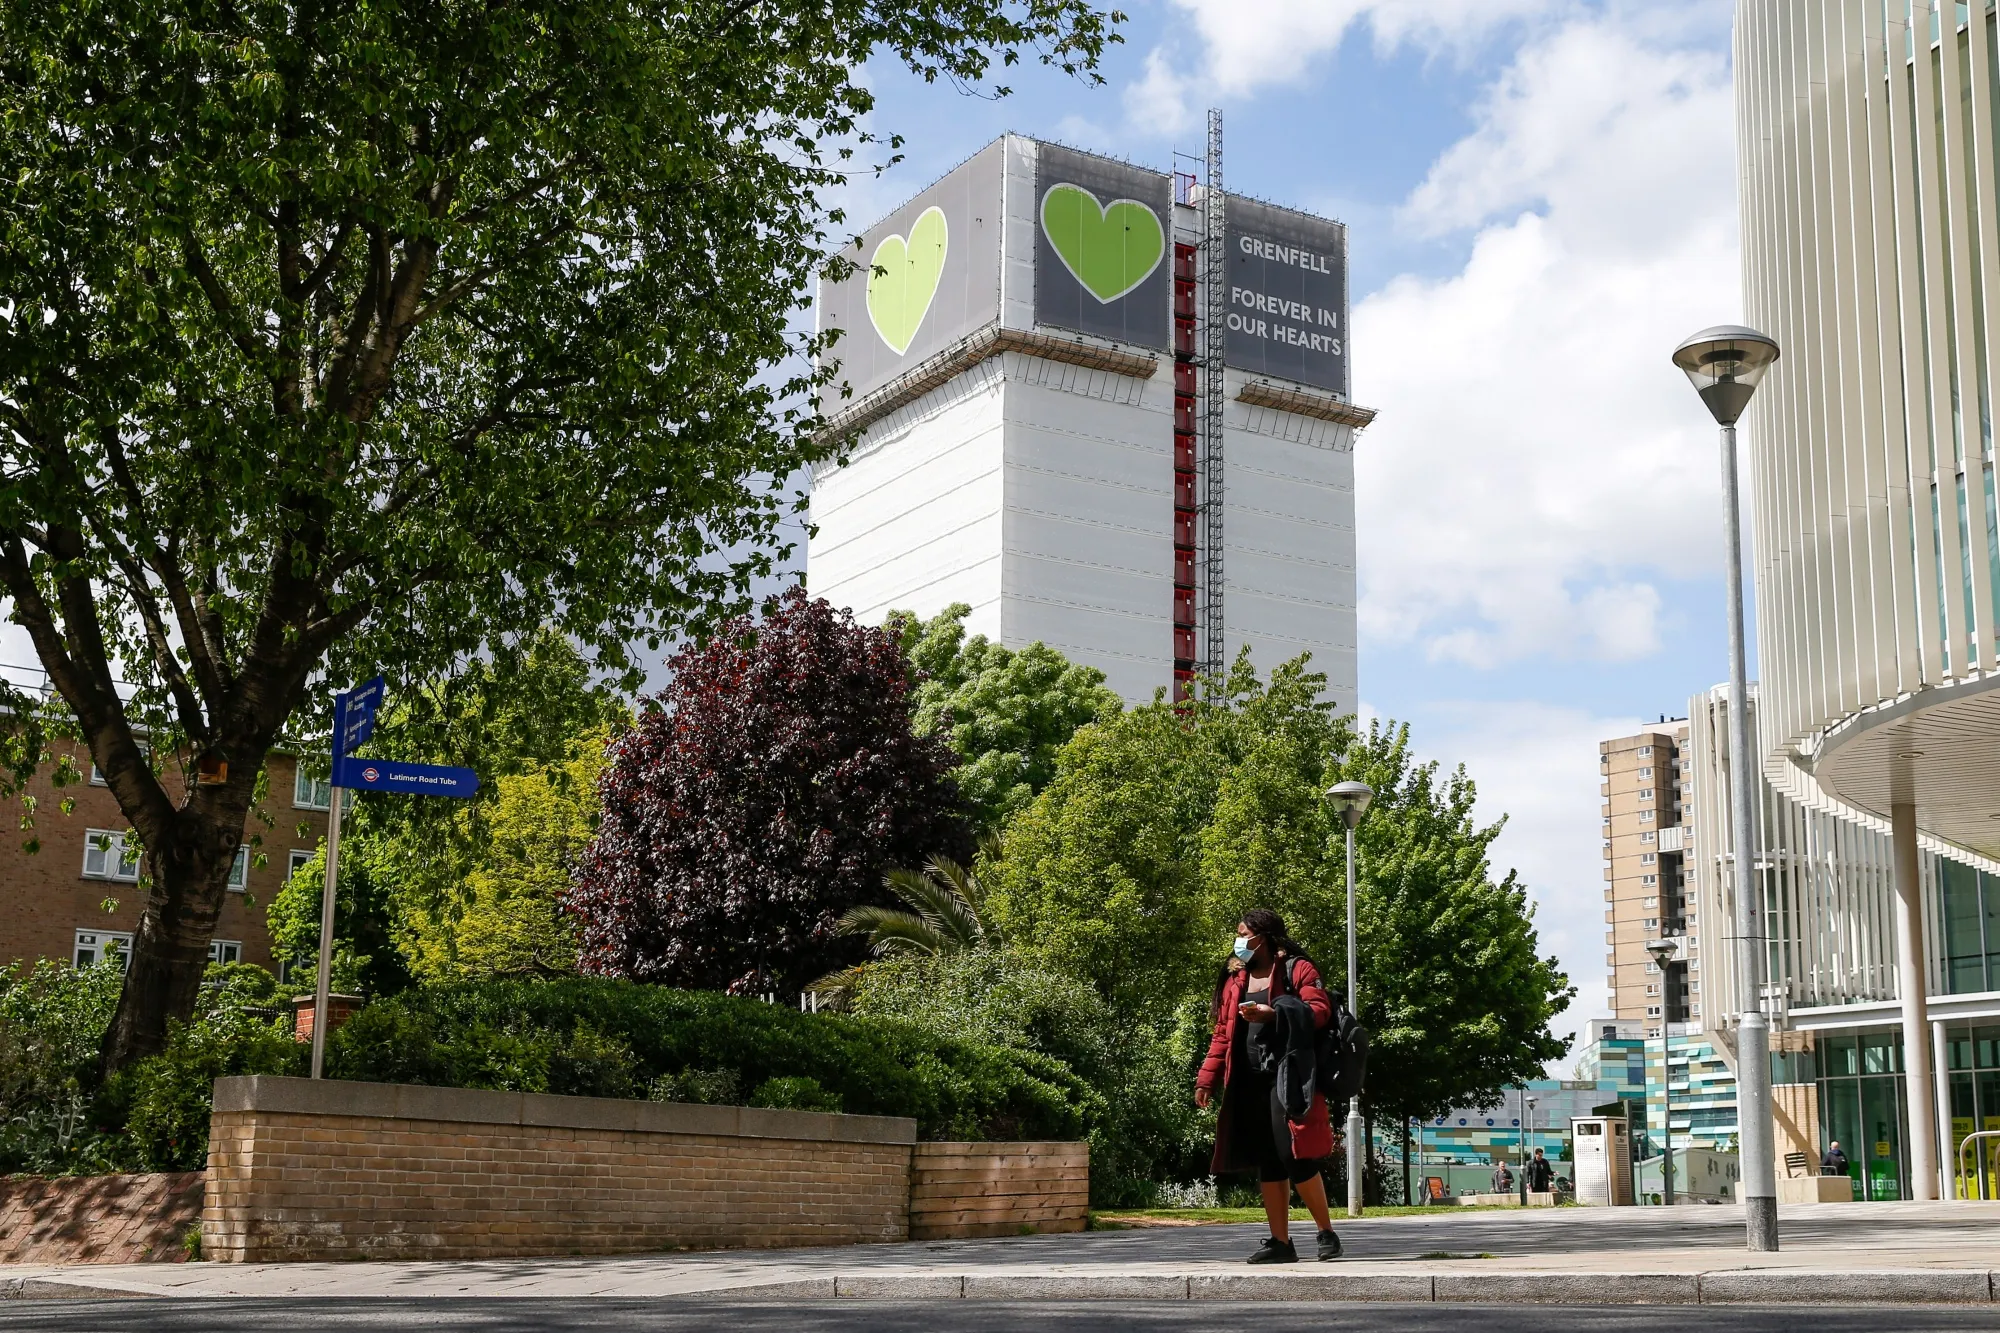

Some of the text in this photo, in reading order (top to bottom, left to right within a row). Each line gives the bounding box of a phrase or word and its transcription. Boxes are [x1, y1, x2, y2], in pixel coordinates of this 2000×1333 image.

[1239, 236, 1331, 275] GRENFELL
[1231, 286, 1337, 329] FOREVER IN
[1226, 313, 1342, 356] OUR HEARTS
[389, 773, 457, 786] Latimer Road Tube
[1871, 1179, 1898, 1191] BETTER
